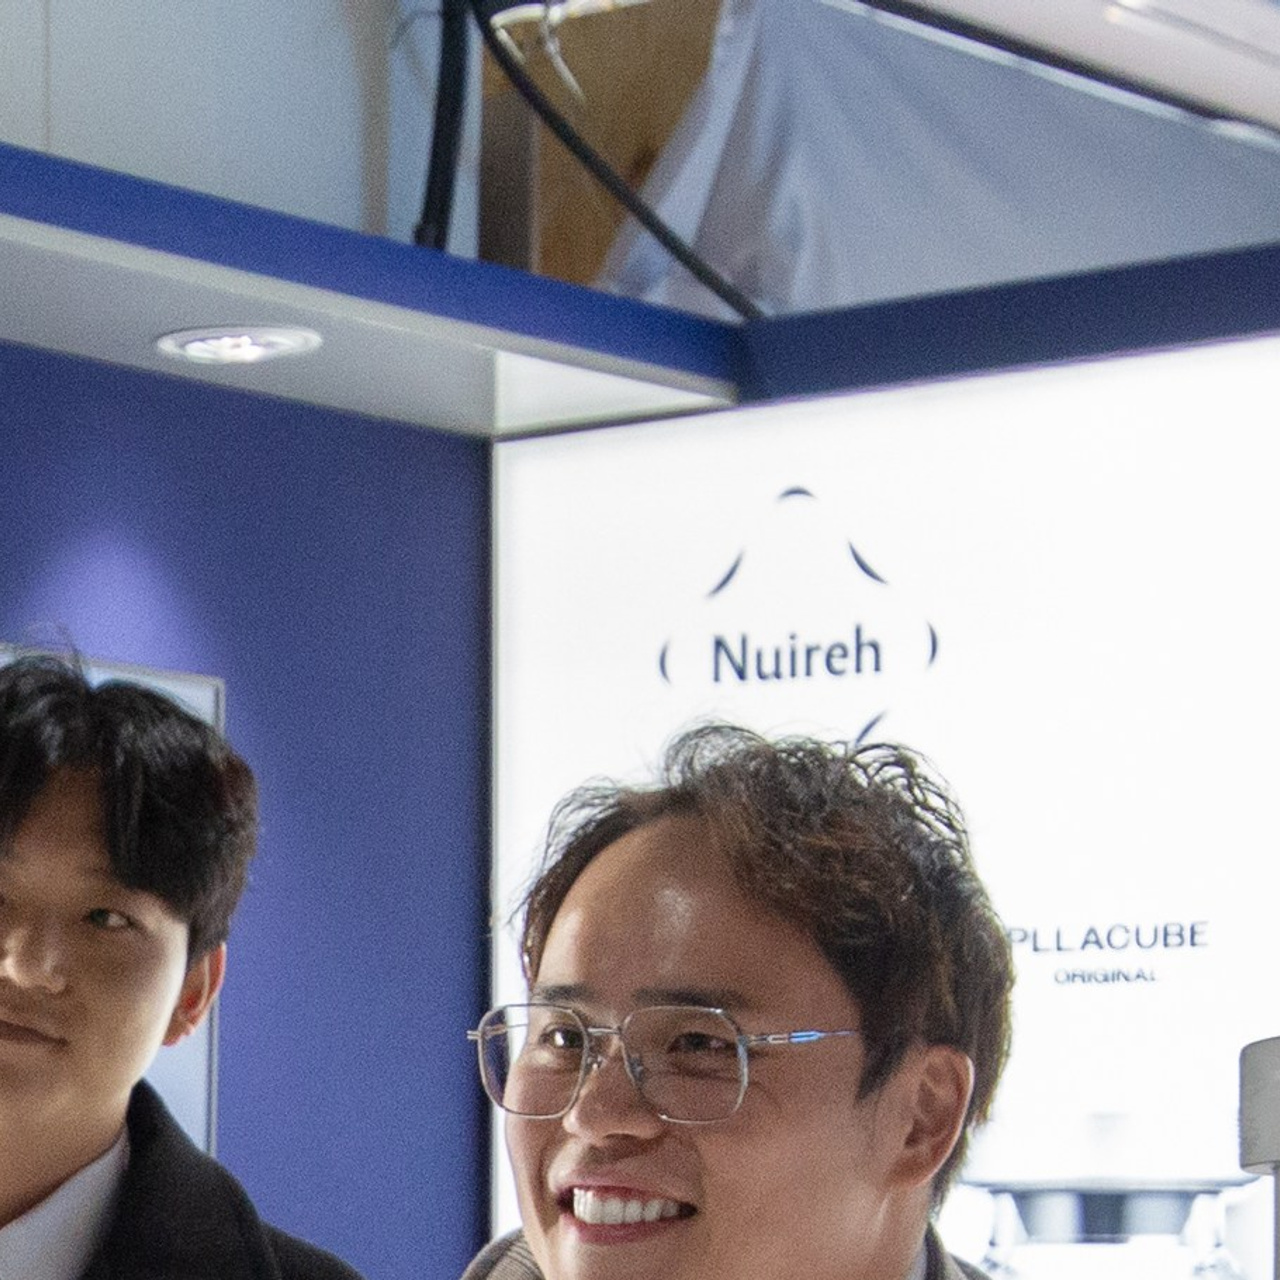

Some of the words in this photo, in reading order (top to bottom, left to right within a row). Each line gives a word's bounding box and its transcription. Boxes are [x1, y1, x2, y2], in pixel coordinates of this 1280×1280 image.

[712, 623, 882, 683] Nuireh
[1006, 920, 1209, 952] PLLACUBE
[1053, 967, 1156, 985] ORIGINAL
